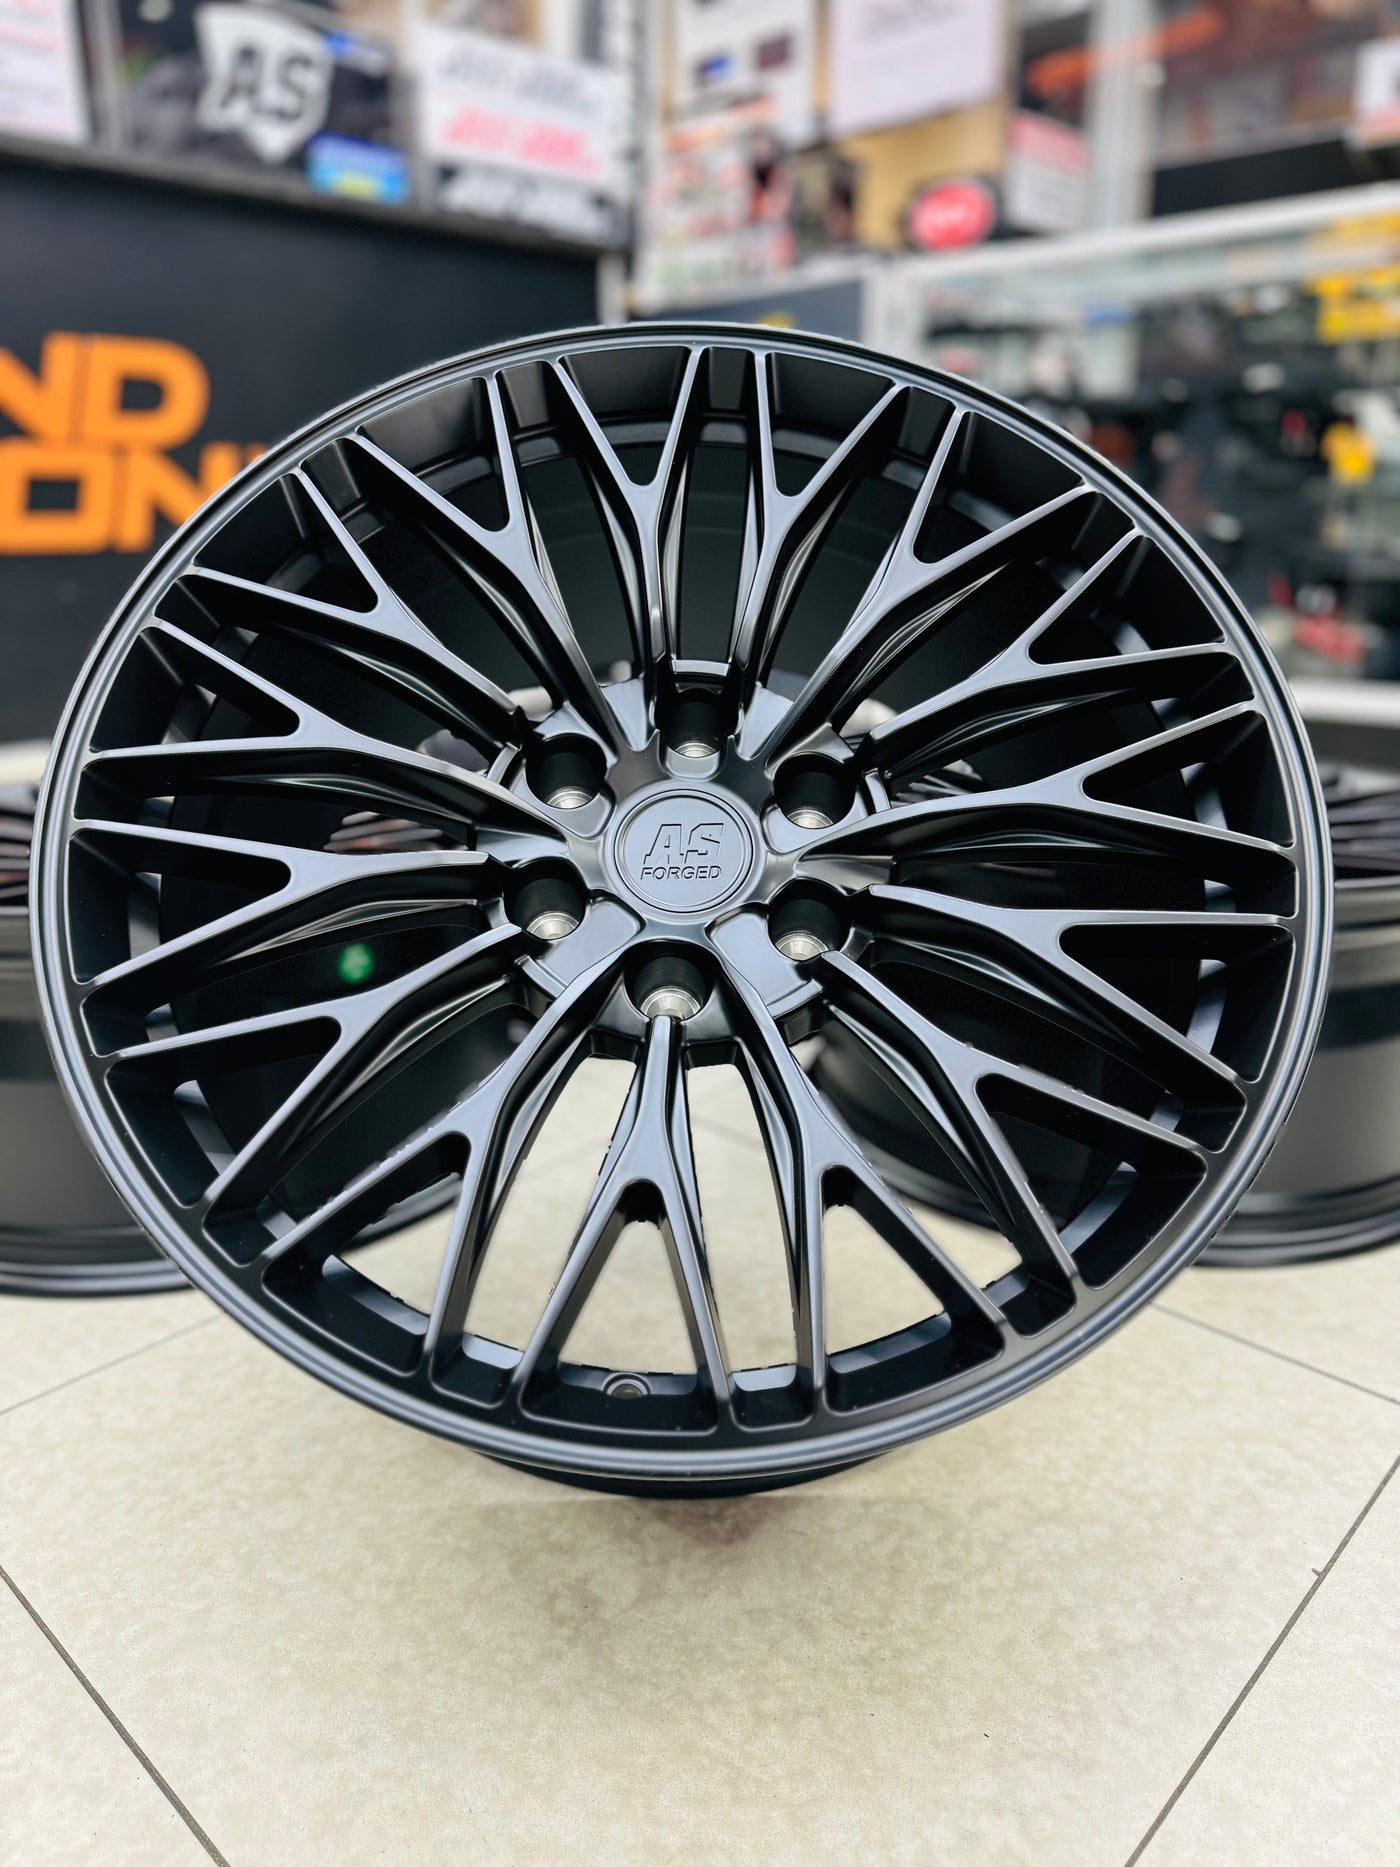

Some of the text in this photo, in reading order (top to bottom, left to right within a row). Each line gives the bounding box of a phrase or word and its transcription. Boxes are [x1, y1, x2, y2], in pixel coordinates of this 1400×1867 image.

[218, 44, 316, 121] AS
[643, 822, 724, 865] AS
[640, 865, 722, 880] FORGED
